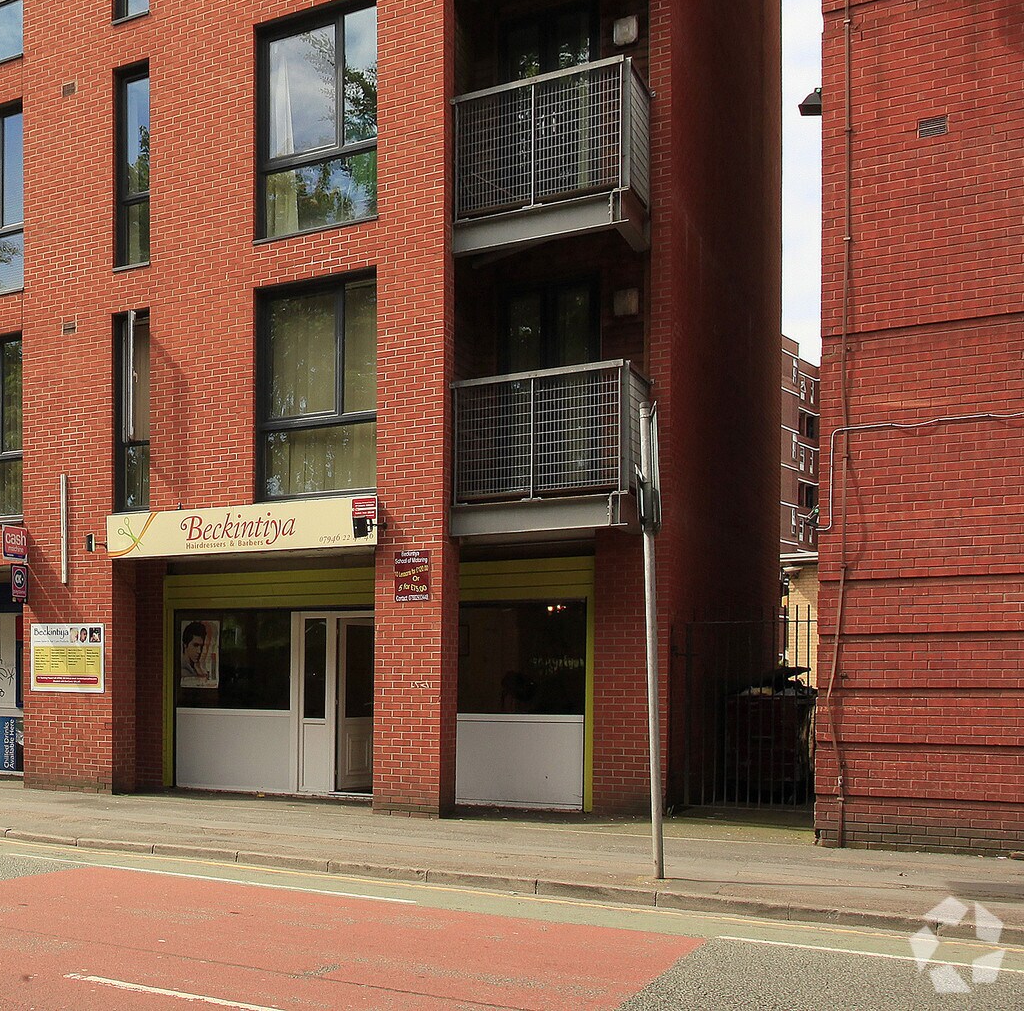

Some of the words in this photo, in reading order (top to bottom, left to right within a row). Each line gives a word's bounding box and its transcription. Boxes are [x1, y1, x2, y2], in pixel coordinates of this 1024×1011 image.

[180, 512, 296, 545] Beckintiya
[5, 530, 27, 547] cash
[186, 541, 226, 550] Hairdressers
[238, 539, 264, 547] Barbers
[398, 584, 403, 592] 5
[34, 626, 69, 639] Beckintiya
